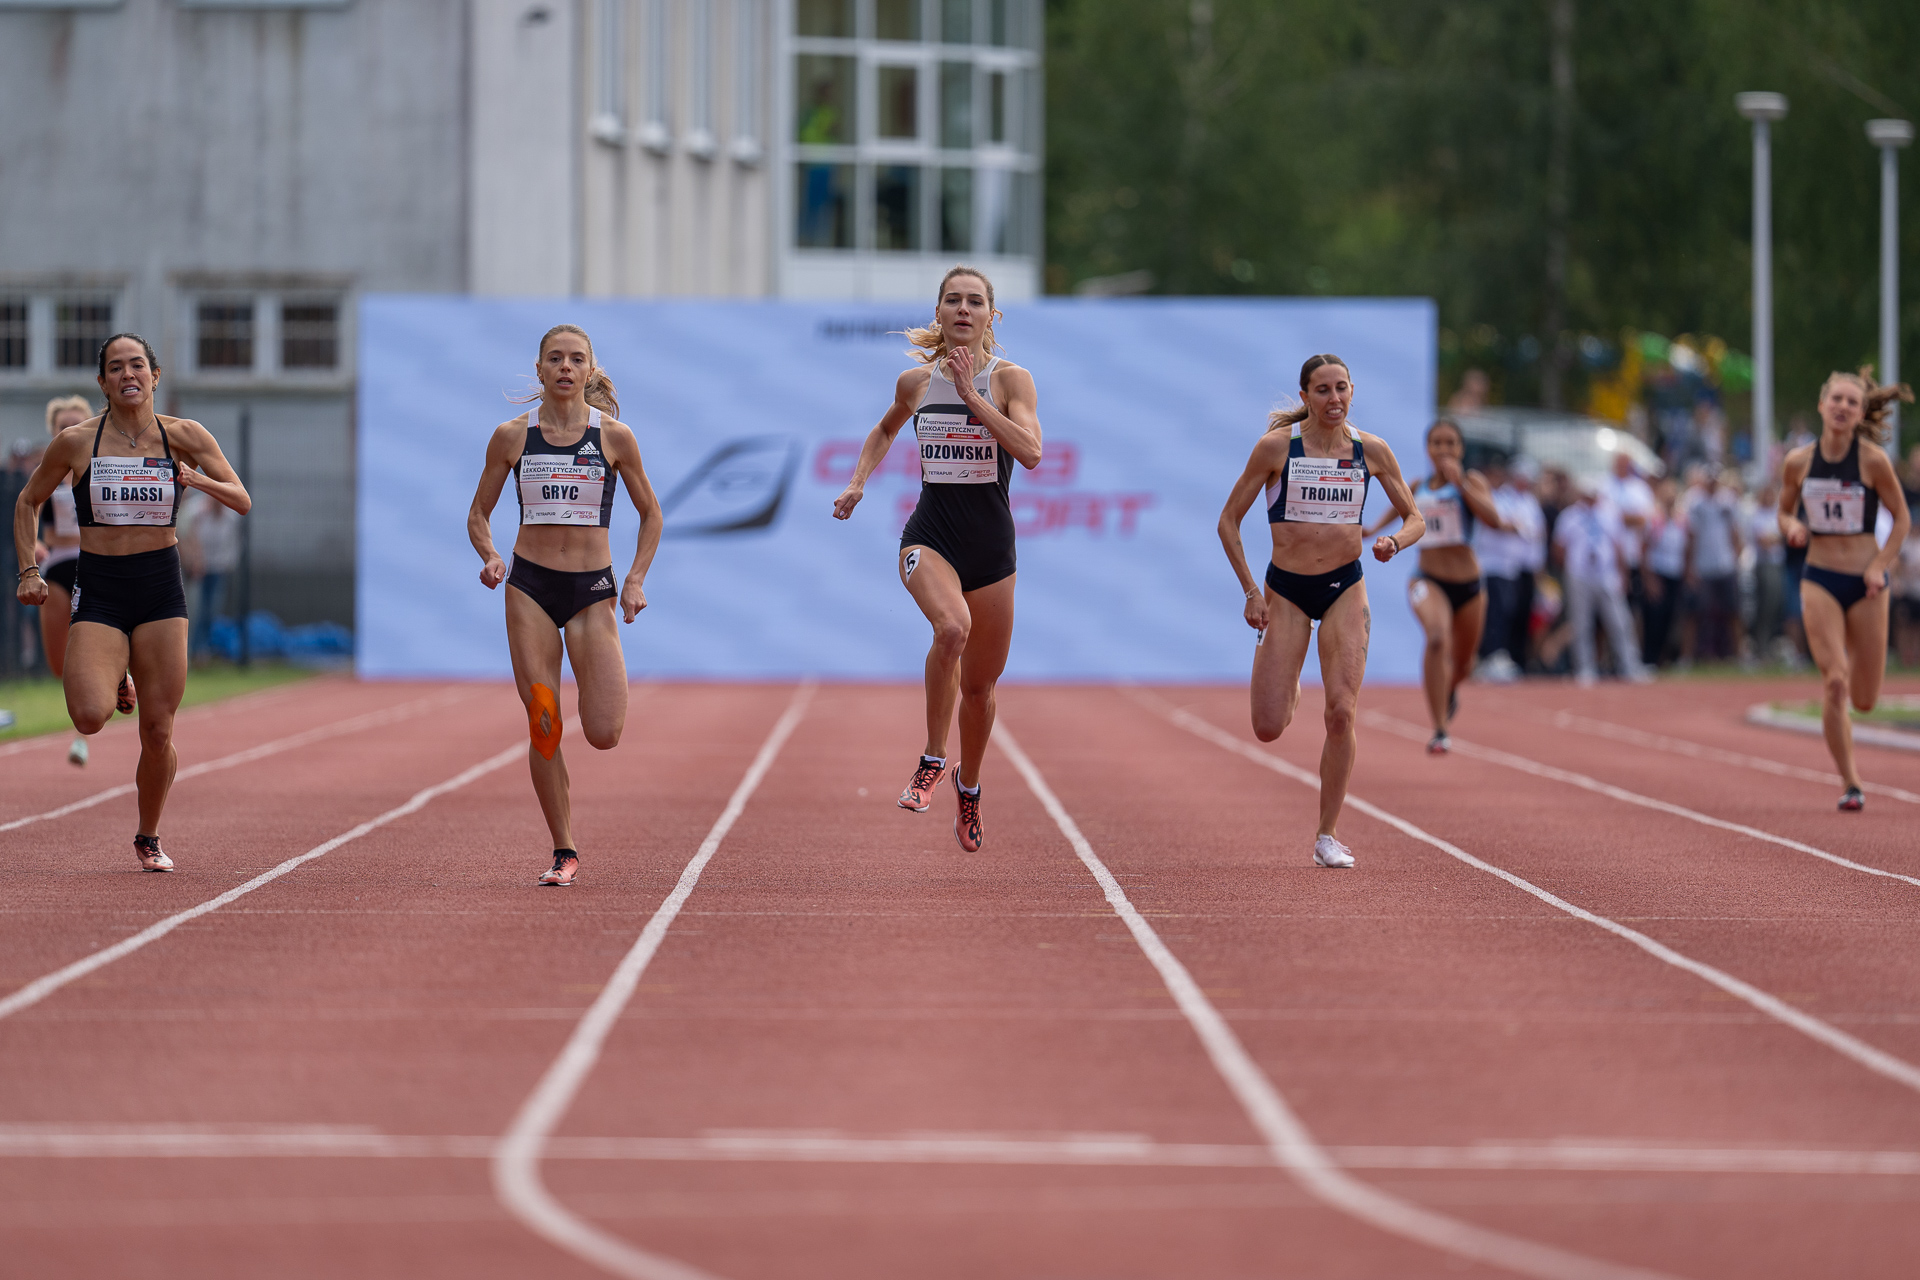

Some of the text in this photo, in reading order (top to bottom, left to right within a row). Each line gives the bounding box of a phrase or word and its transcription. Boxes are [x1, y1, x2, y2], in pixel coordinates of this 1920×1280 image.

[921, 444, 993, 460] ŁOZOWSKA
[120, 487, 163, 502] BASSI
[542, 485, 579, 500] GRYC
[1301, 486, 1353, 502] TROIANI
[1824, 502, 1842, 520] 14
[906, 552, 916, 575] 5
